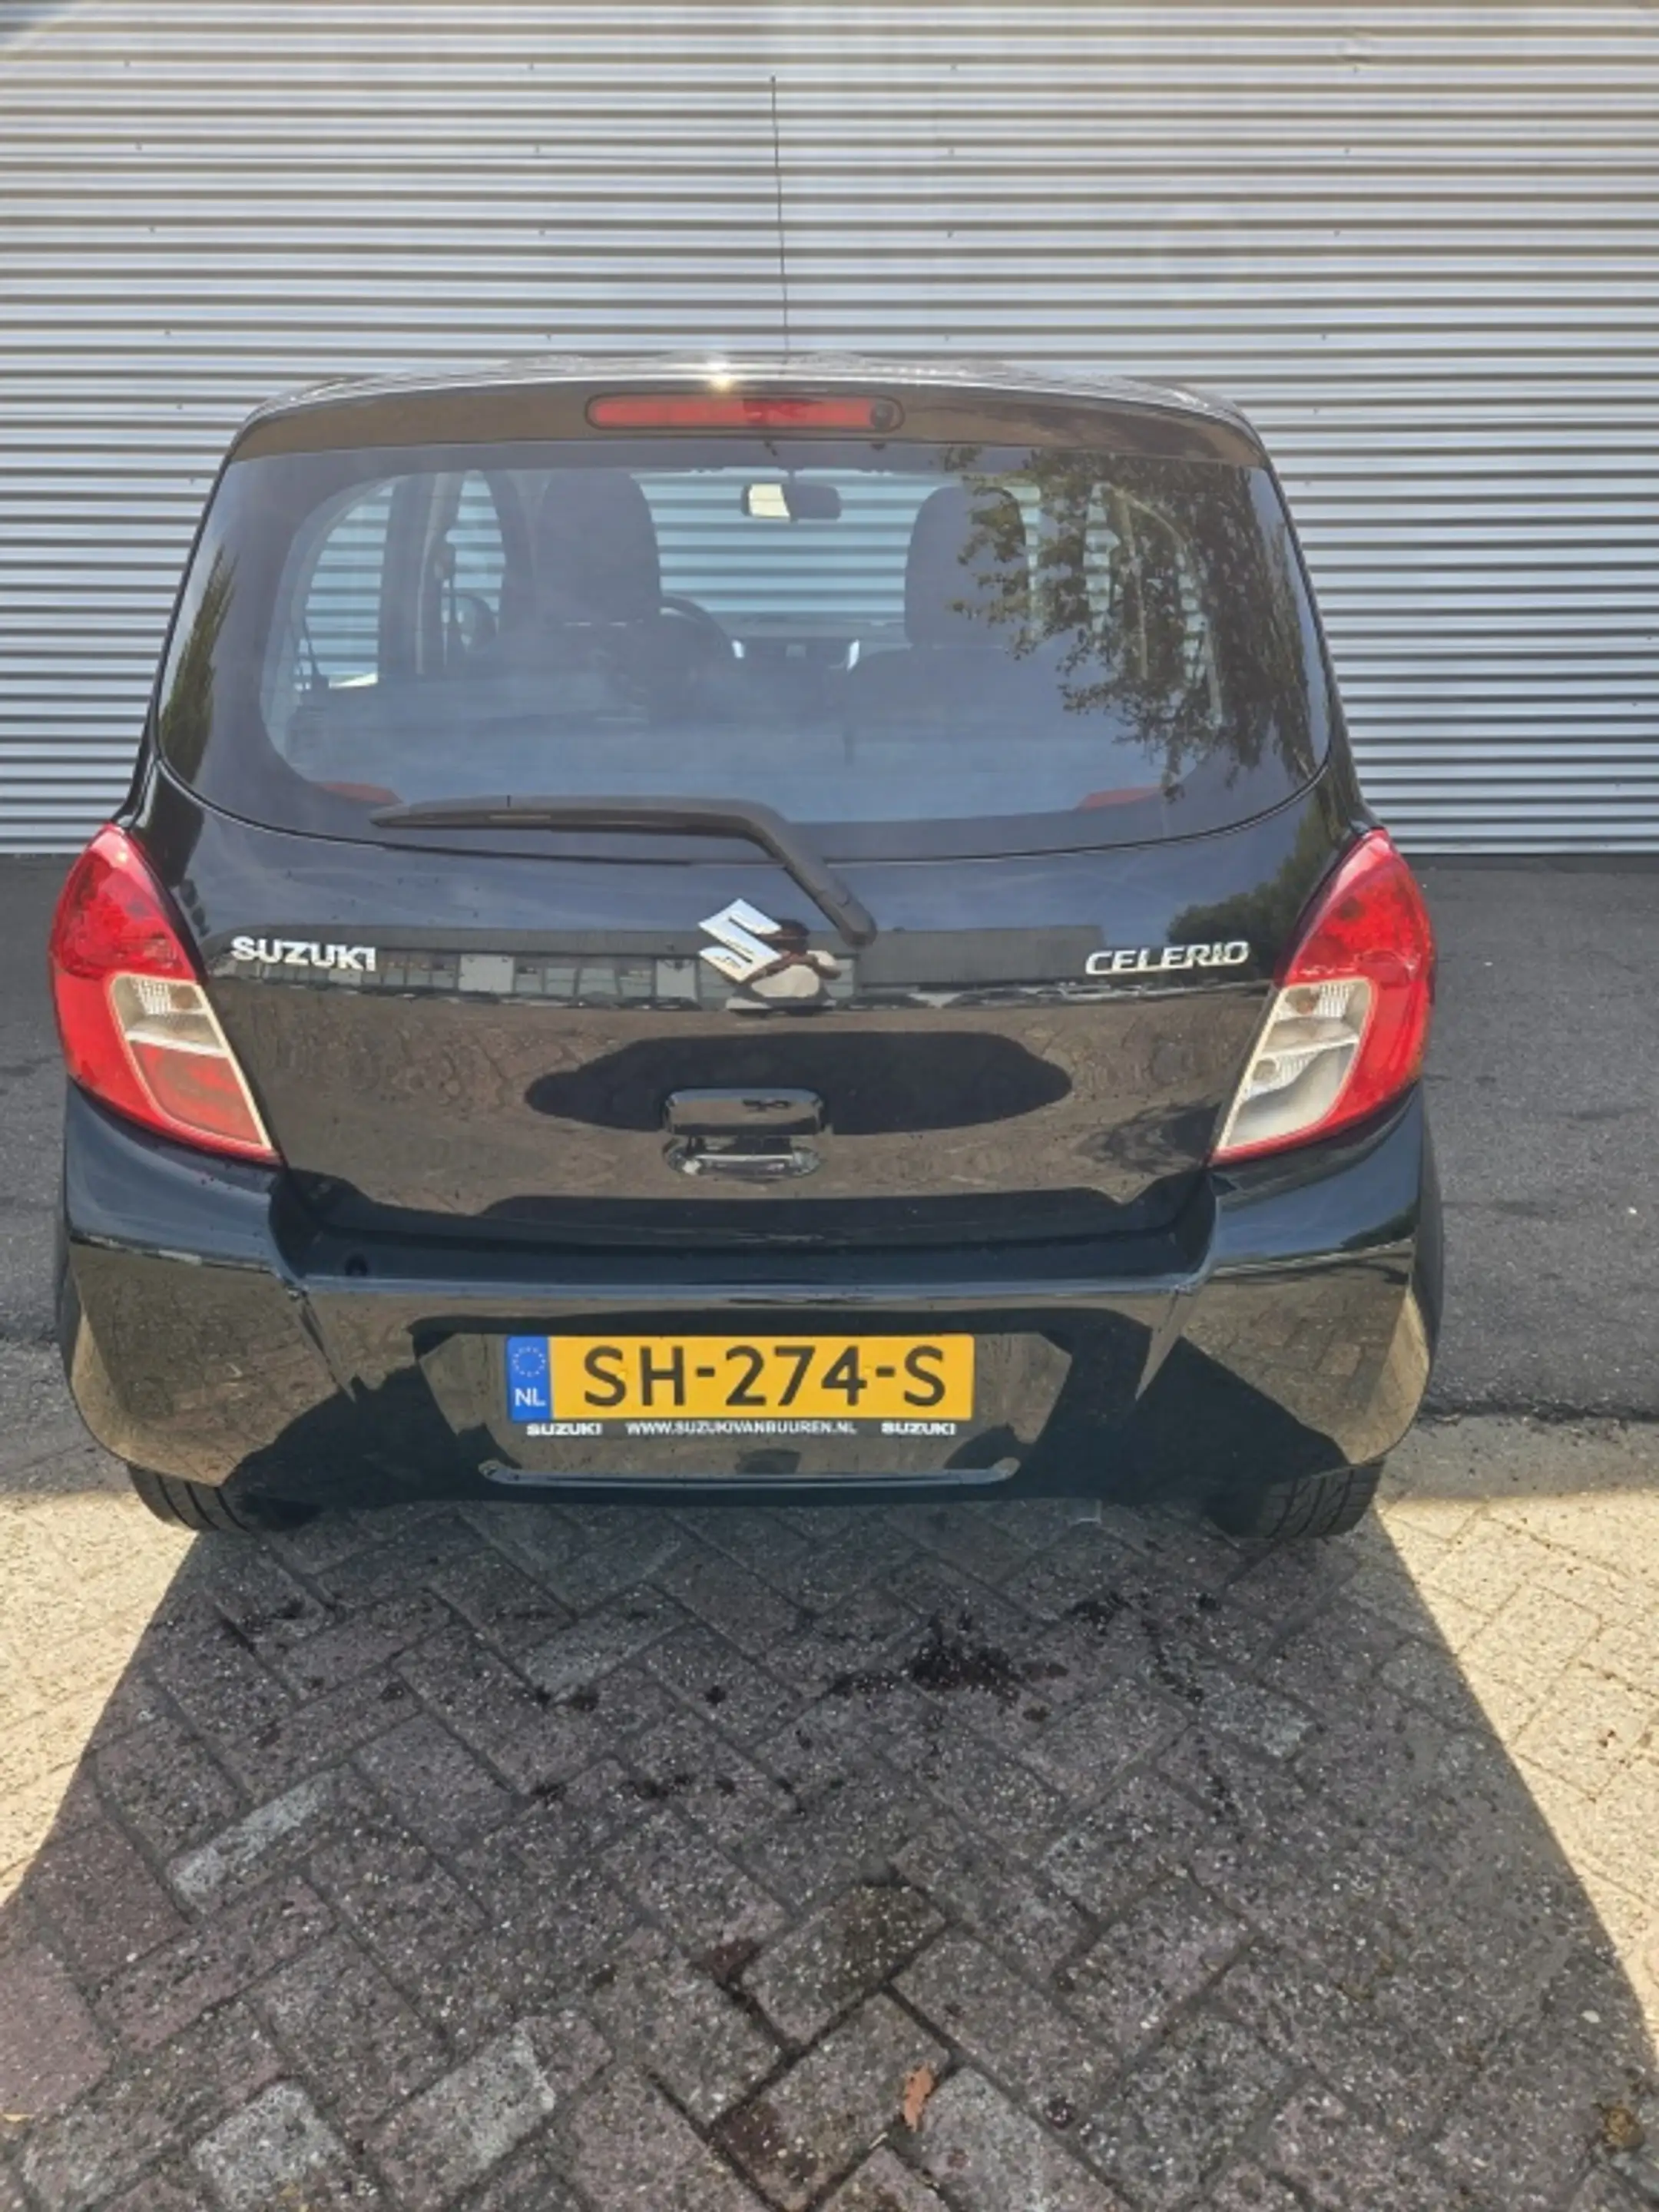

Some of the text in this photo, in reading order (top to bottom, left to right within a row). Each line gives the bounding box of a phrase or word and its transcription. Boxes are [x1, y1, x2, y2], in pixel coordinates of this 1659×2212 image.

[230, 935, 376, 972] SUZUKI
[1085, 940, 1250, 975] CELERIO
[584, 1345, 945, 1406] SH-274-S
[514, 1387, 547, 1407] NL
[526, 1422, 603, 1436] SUZUKI
[625, 1421, 857, 1435] WWW.SUZUKIVANBUUREN.NL
[881, 1422, 956, 1435] SUZUKI
